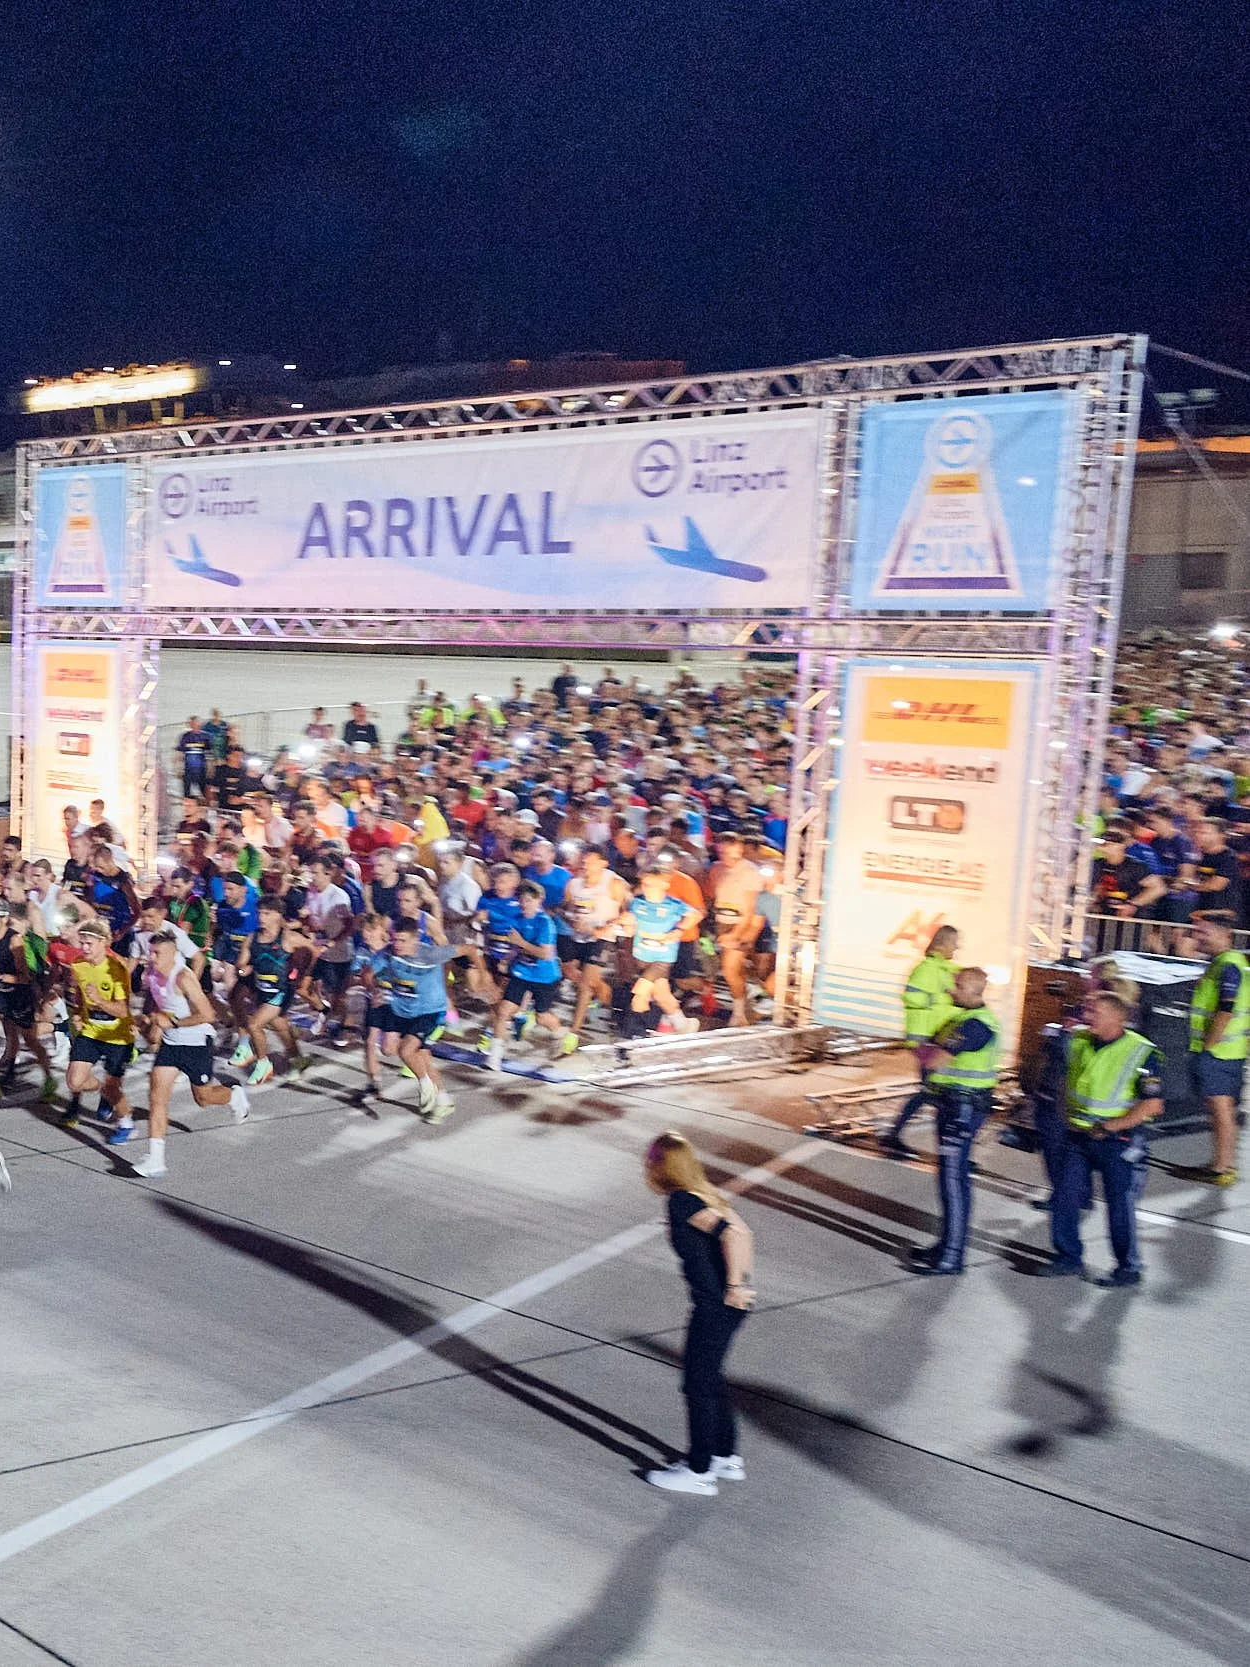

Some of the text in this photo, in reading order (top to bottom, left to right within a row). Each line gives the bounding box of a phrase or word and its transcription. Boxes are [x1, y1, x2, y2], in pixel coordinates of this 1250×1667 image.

[688, 437, 749, 463] Linz
[687, 466, 788, 498] Airport
[295, 491, 574, 559] ARRIVAL
[863, 756, 999, 784] weekend
